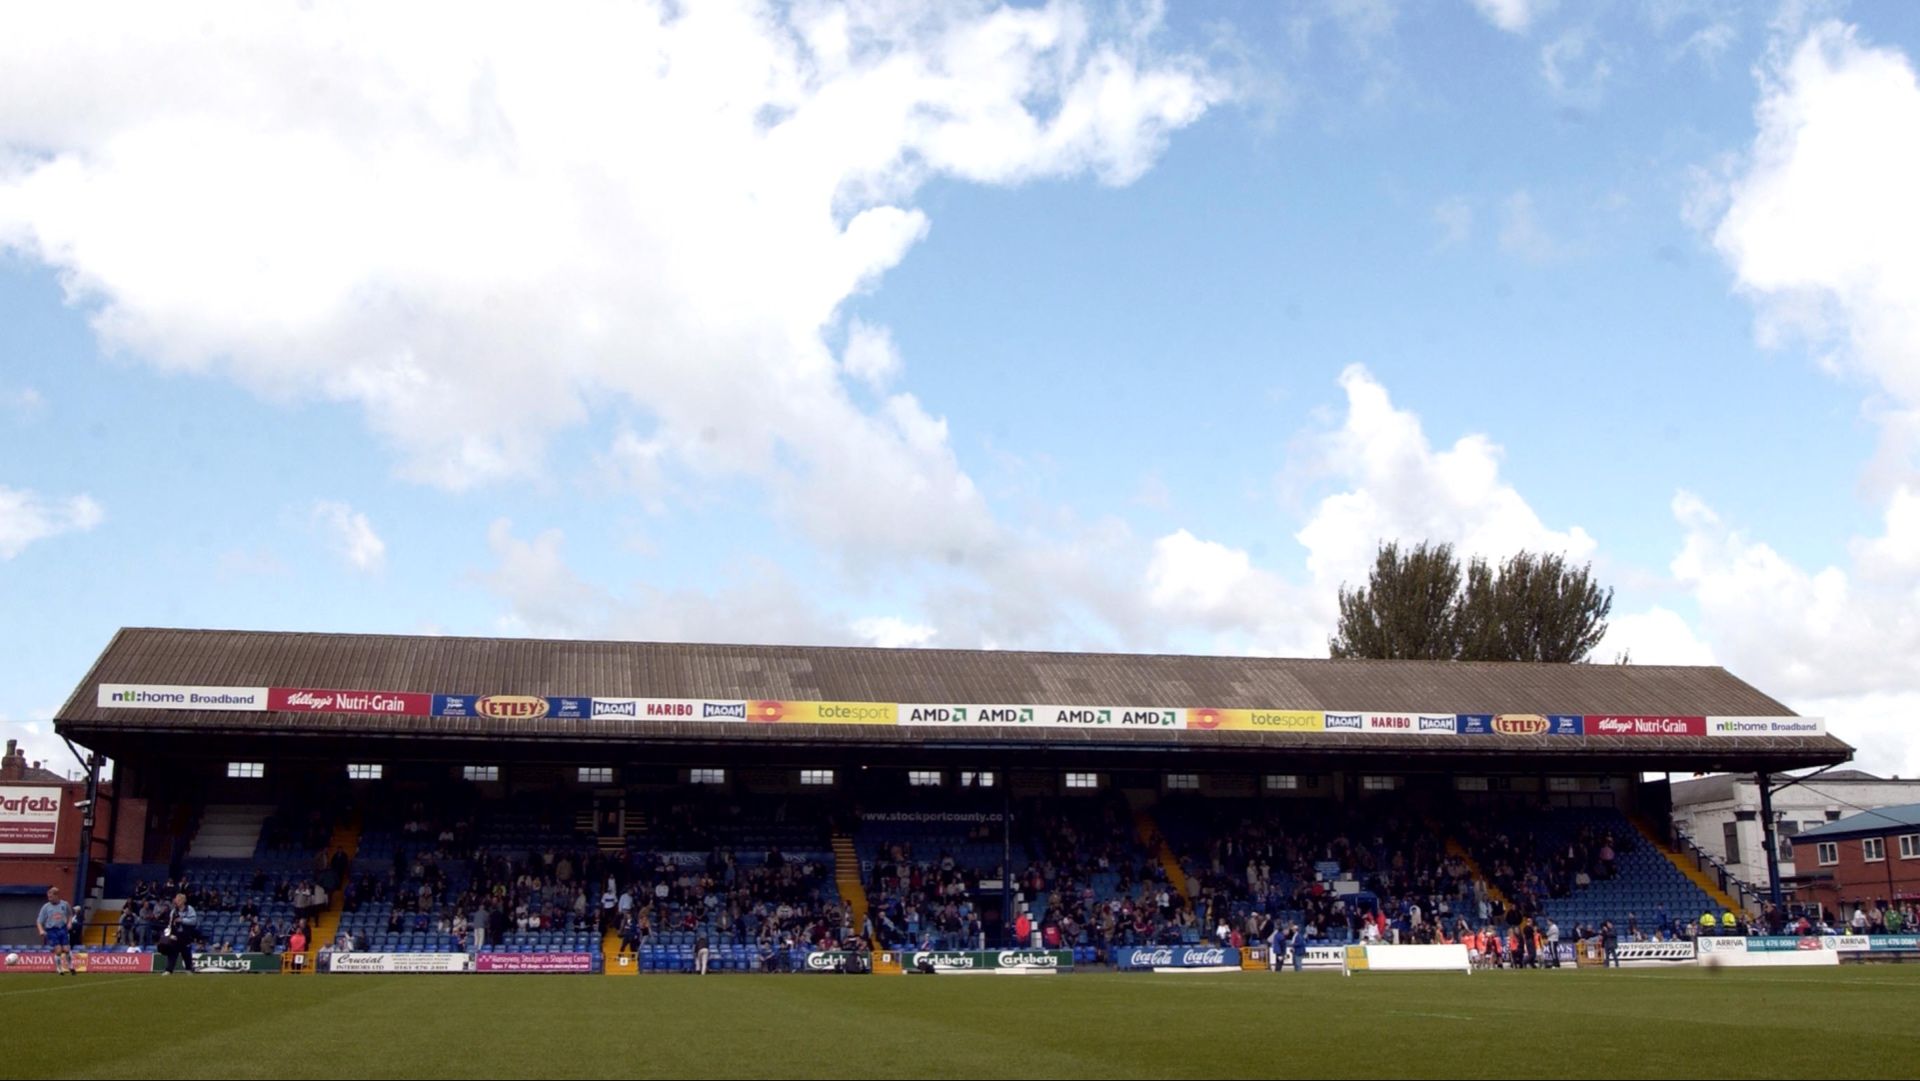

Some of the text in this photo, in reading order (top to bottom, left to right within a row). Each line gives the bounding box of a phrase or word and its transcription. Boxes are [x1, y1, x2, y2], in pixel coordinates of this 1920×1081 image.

[112, 690, 255, 705] ntl:home Broadband
[286, 691, 405, 712] Kellogg's Nutri-Grain
[480, 698, 546, 716] TETLEY'S
[594, 702, 635, 716] MAOAM
[646, 703, 694, 716] HARIBO
[703, 704, 745, 718] MAOAM
[817, 704, 890, 721] totesport
[910, 707, 950, 722] AMD
[978, 708, 1017, 723] AMD
[1056, 709, 1095, 724] AMD
[1121, 711, 1160, 725] AMD
[1251, 712, 1317, 728] totesport
[1326, 715, 1362, 729] MAOAM
[1371, 716, 1411, 729] HARIBO
[1419, 718, 1454, 731] MAOAM
[1494, 716, 1548, 733] TETLEY'S
[1598, 717, 1688, 734] Kellogg's Nutri-Grain
[1716, 721, 1818, 732] ntl:home Broadband
[861, 812, 1015, 823] ww.stockportcounty.co
[1617, 943, 1692, 951] WW.TFGSPORTS.COM
[1715, 939, 1744, 947] ARRIVA
[1839, 937, 1867, 945] ARRIVA
[90, 956, 140, 965] SCANDIA
[337, 953, 384, 964] Crucial
[998, 950, 1058, 968] Carlsberg
